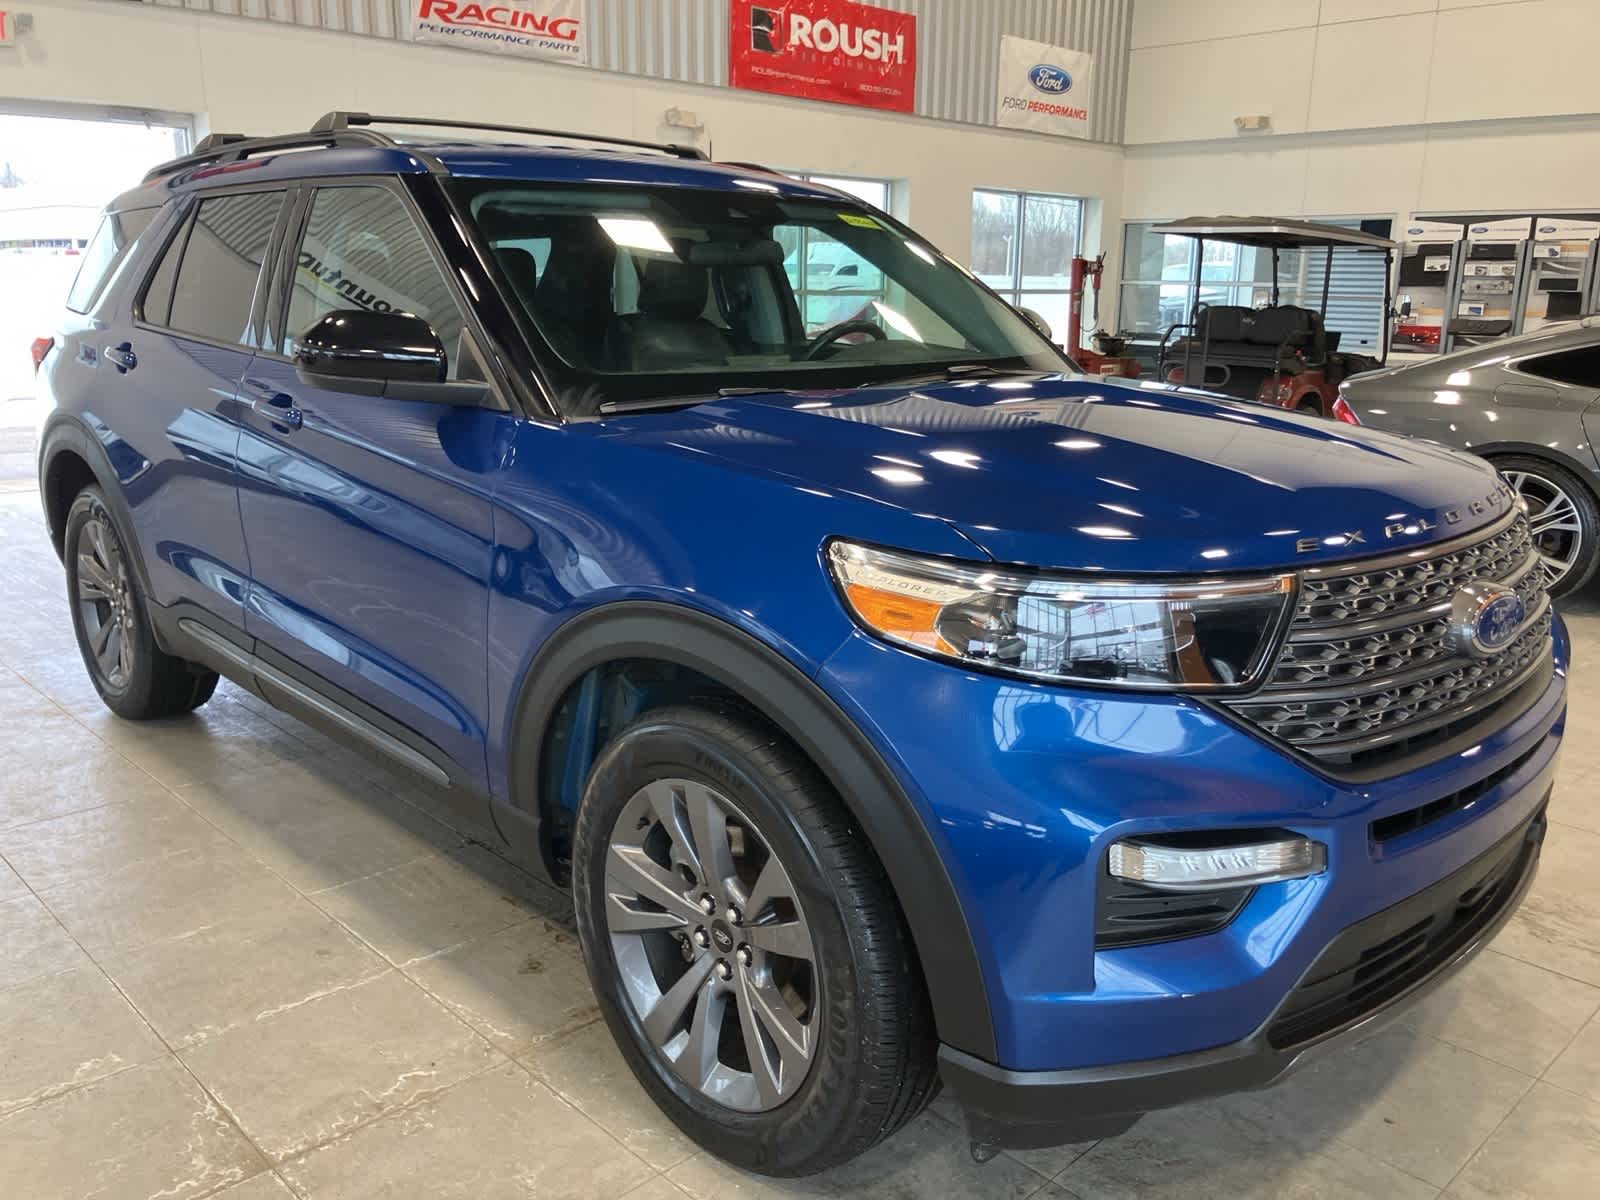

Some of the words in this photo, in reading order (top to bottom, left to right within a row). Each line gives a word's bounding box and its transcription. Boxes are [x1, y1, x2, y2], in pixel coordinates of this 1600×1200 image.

[419, 0, 579, 41] RACING
[419, 23, 535, 46] PERFORMANCE
[539, 40, 580, 53] PARTS
[790, 13, 904, 64] ROUSH
[1035, 68, 1064, 91] Ford
[1002, 96, 1027, 110] FORD
[1027, 100, 1088, 120] PERFORMANCE
